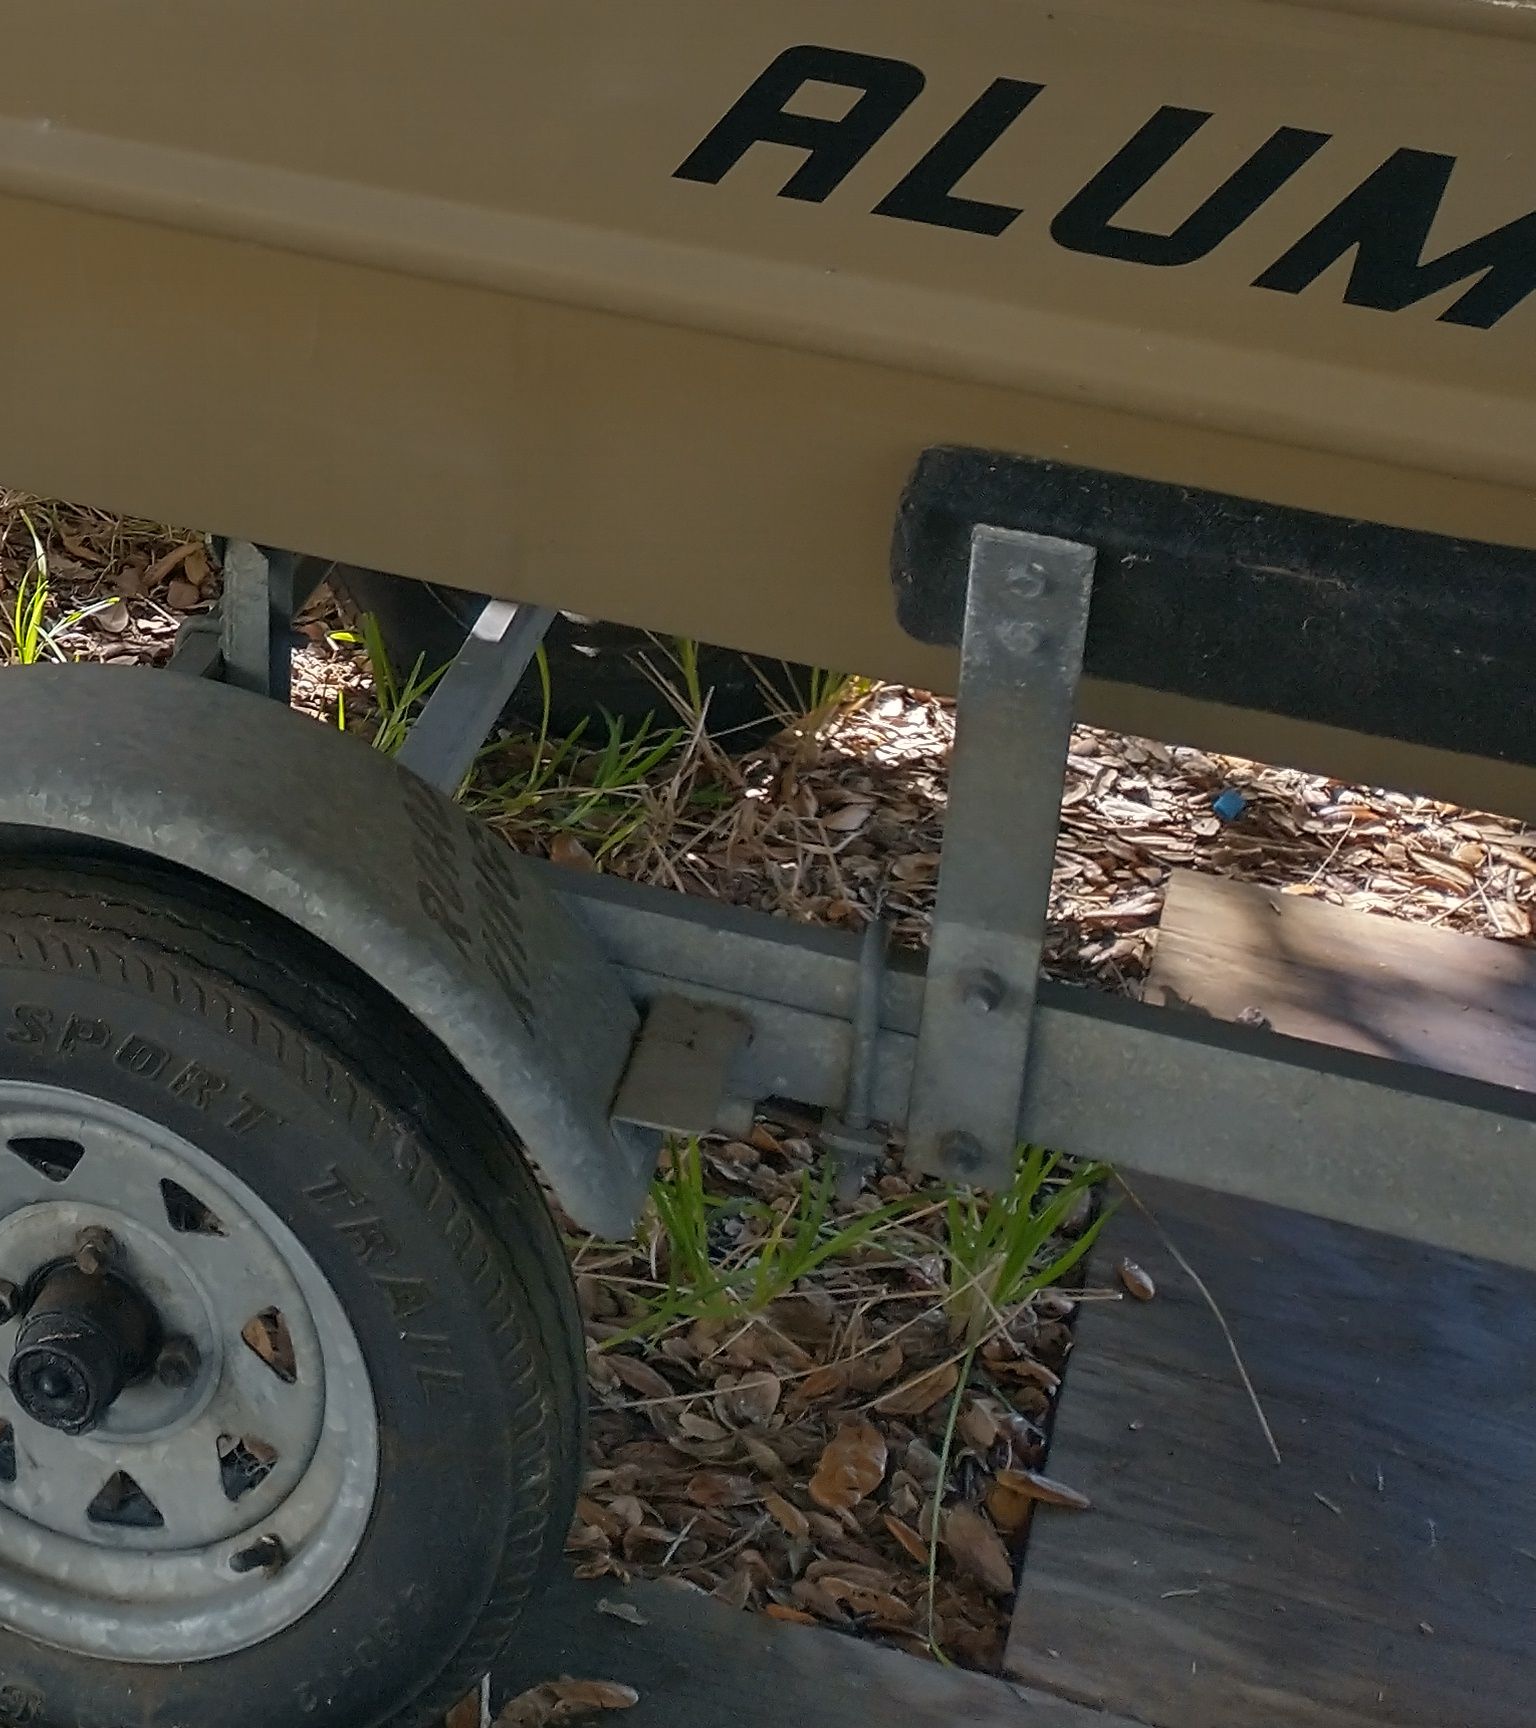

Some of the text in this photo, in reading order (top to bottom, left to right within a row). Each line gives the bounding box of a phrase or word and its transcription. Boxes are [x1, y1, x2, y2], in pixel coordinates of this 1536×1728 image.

[671, 43, 1536, 329] ALUM
[5, 1002, 465, 1406] SPORT TRAIL
